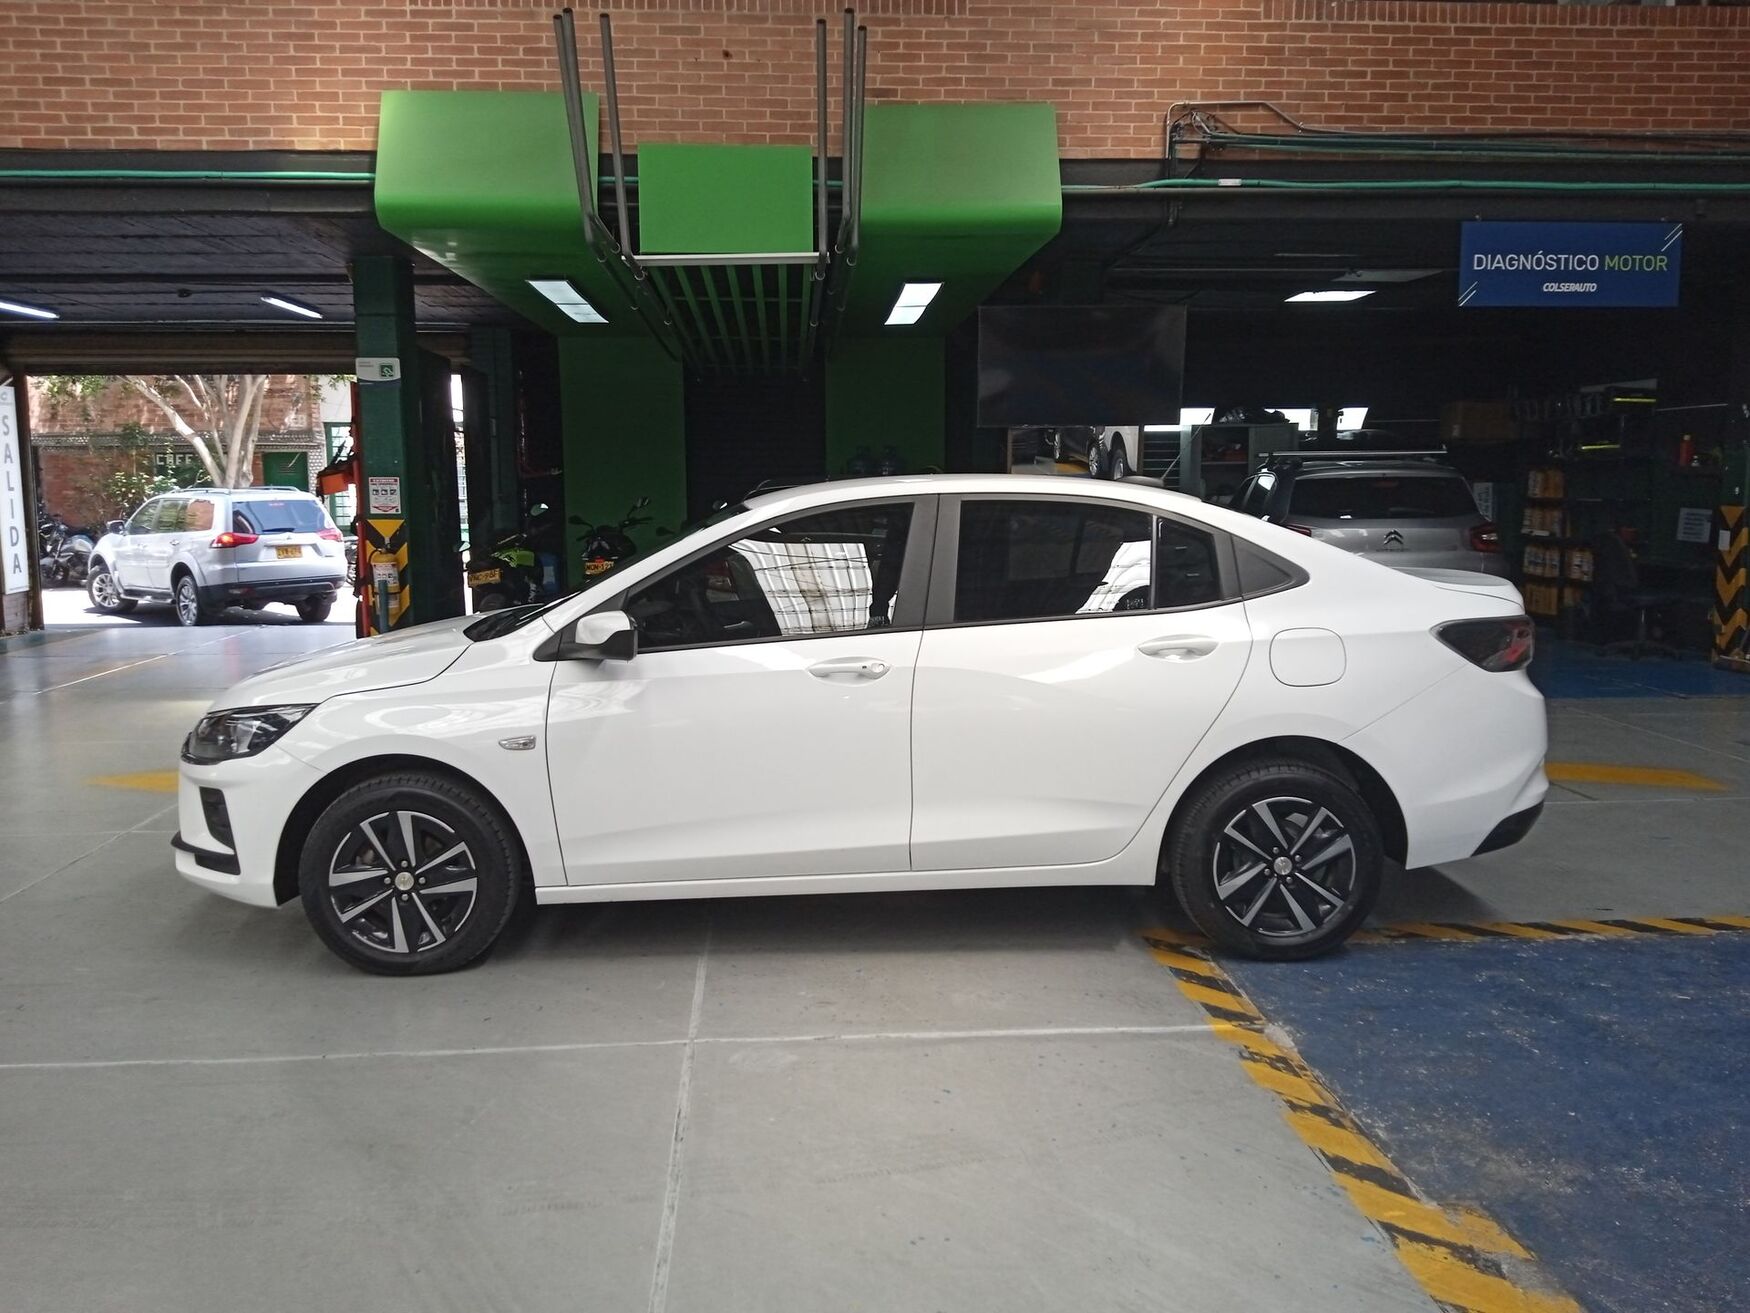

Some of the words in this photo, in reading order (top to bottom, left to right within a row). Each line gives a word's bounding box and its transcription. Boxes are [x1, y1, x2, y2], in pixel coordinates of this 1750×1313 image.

[1473, 250, 1599, 271] DIAGNÓSTICO
[1604, 254, 1668, 271] MOTOR
[1542, 282, 1598, 293] COLSERAUTO
[2, 414, 22, 574] SALIDA
